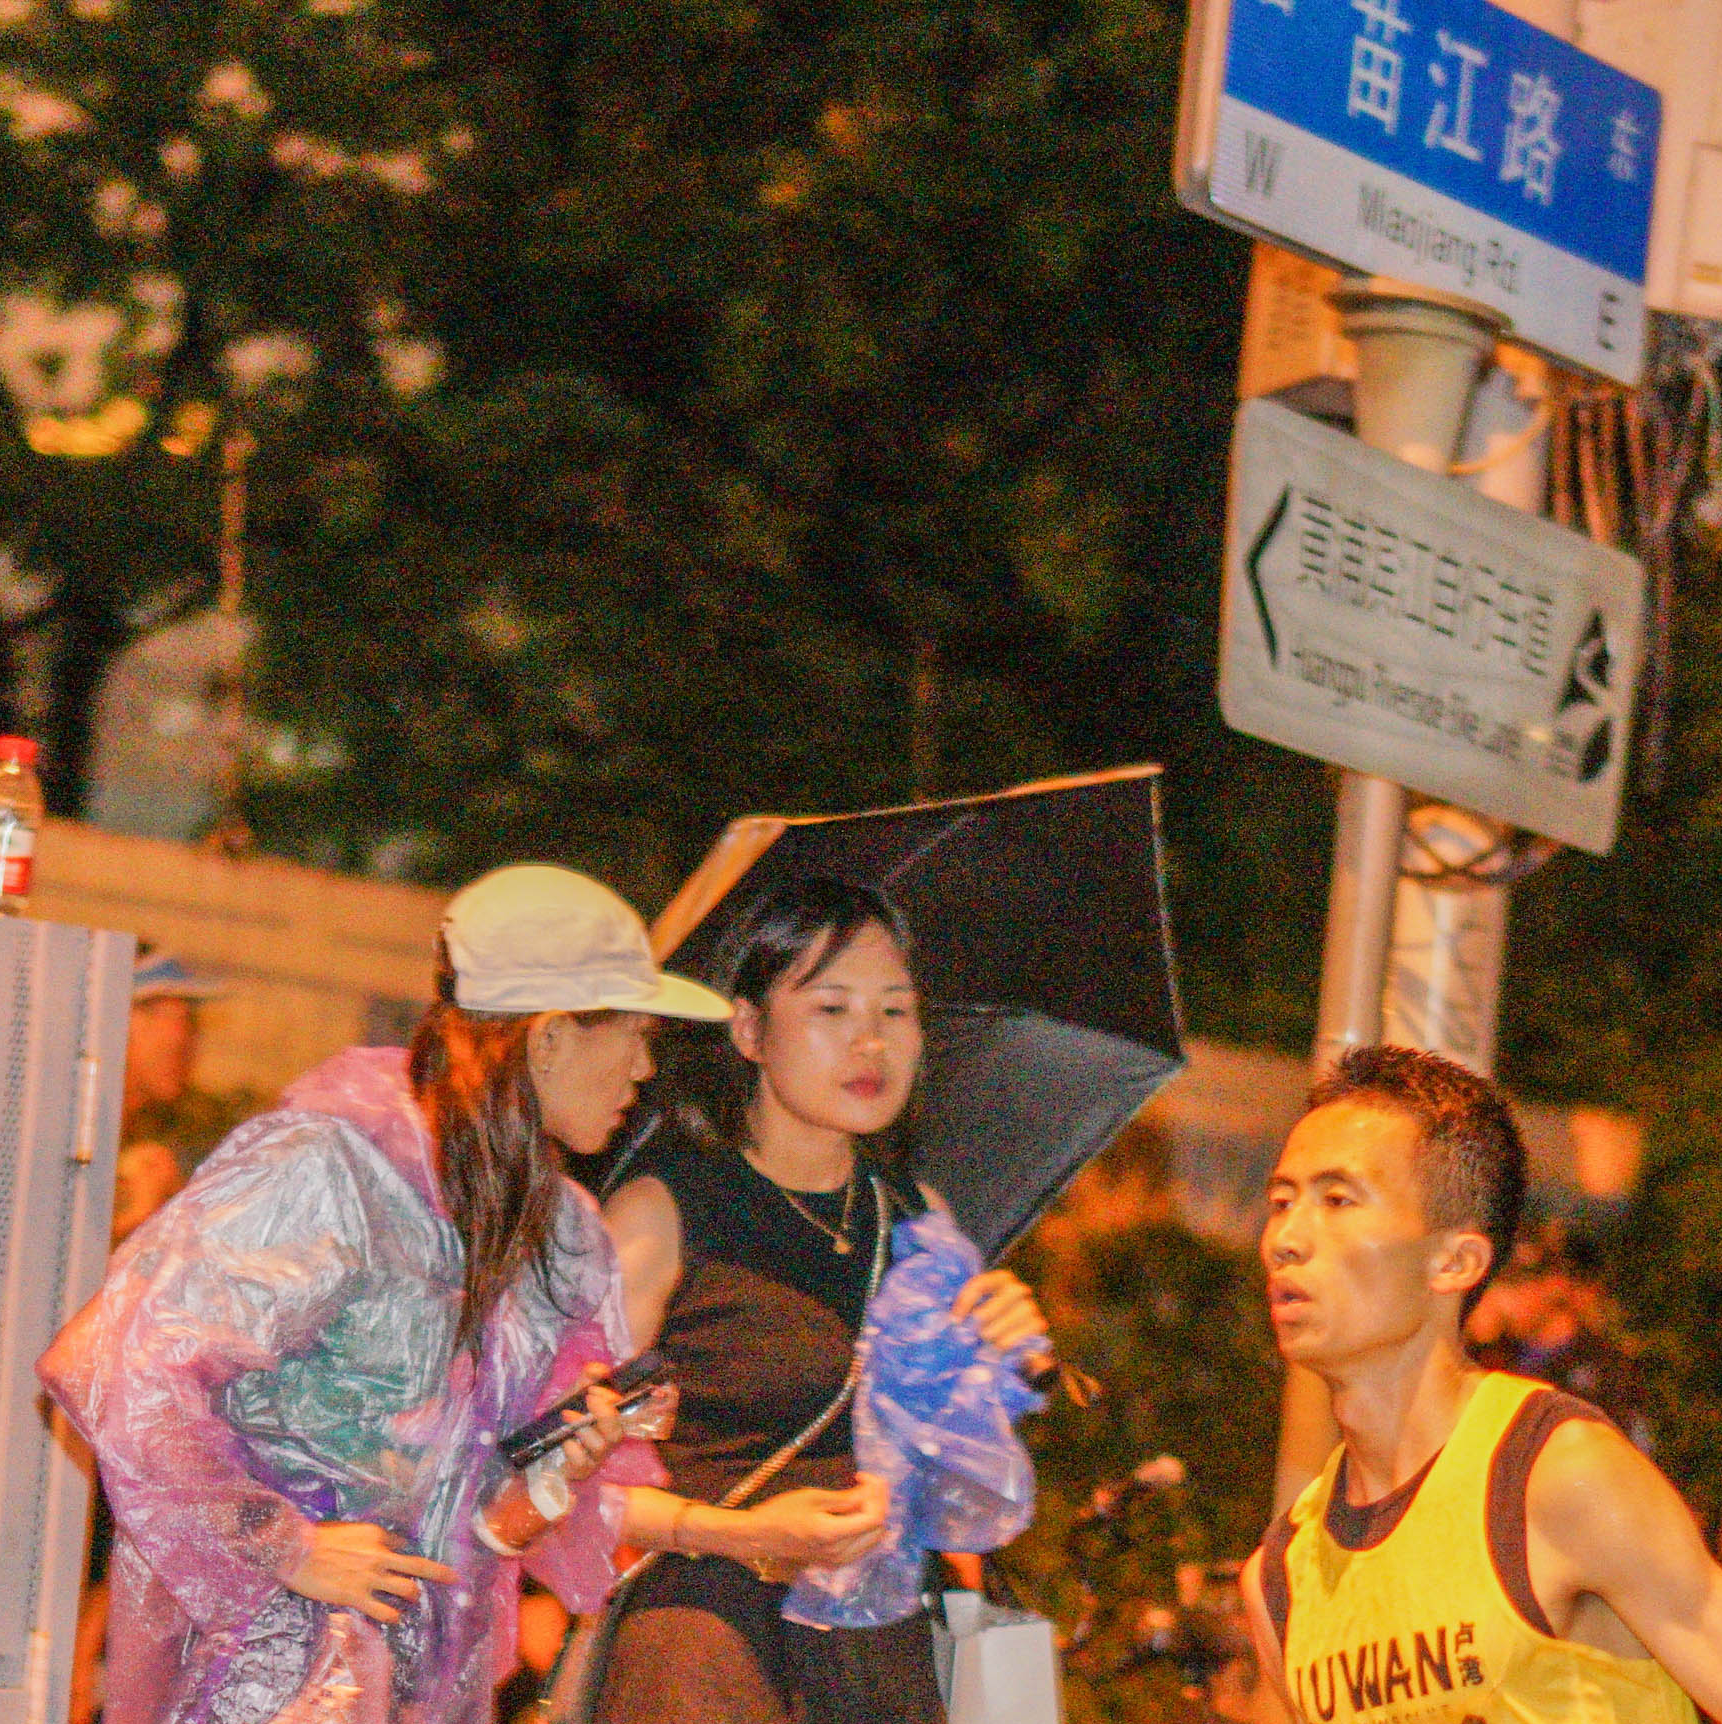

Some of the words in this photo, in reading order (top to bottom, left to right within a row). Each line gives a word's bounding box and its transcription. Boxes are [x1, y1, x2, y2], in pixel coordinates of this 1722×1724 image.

[1347, 0, 1563, 206] 苗江路
[1244, 129, 1282, 199] W
[1597, 288, 1620, 354] E
